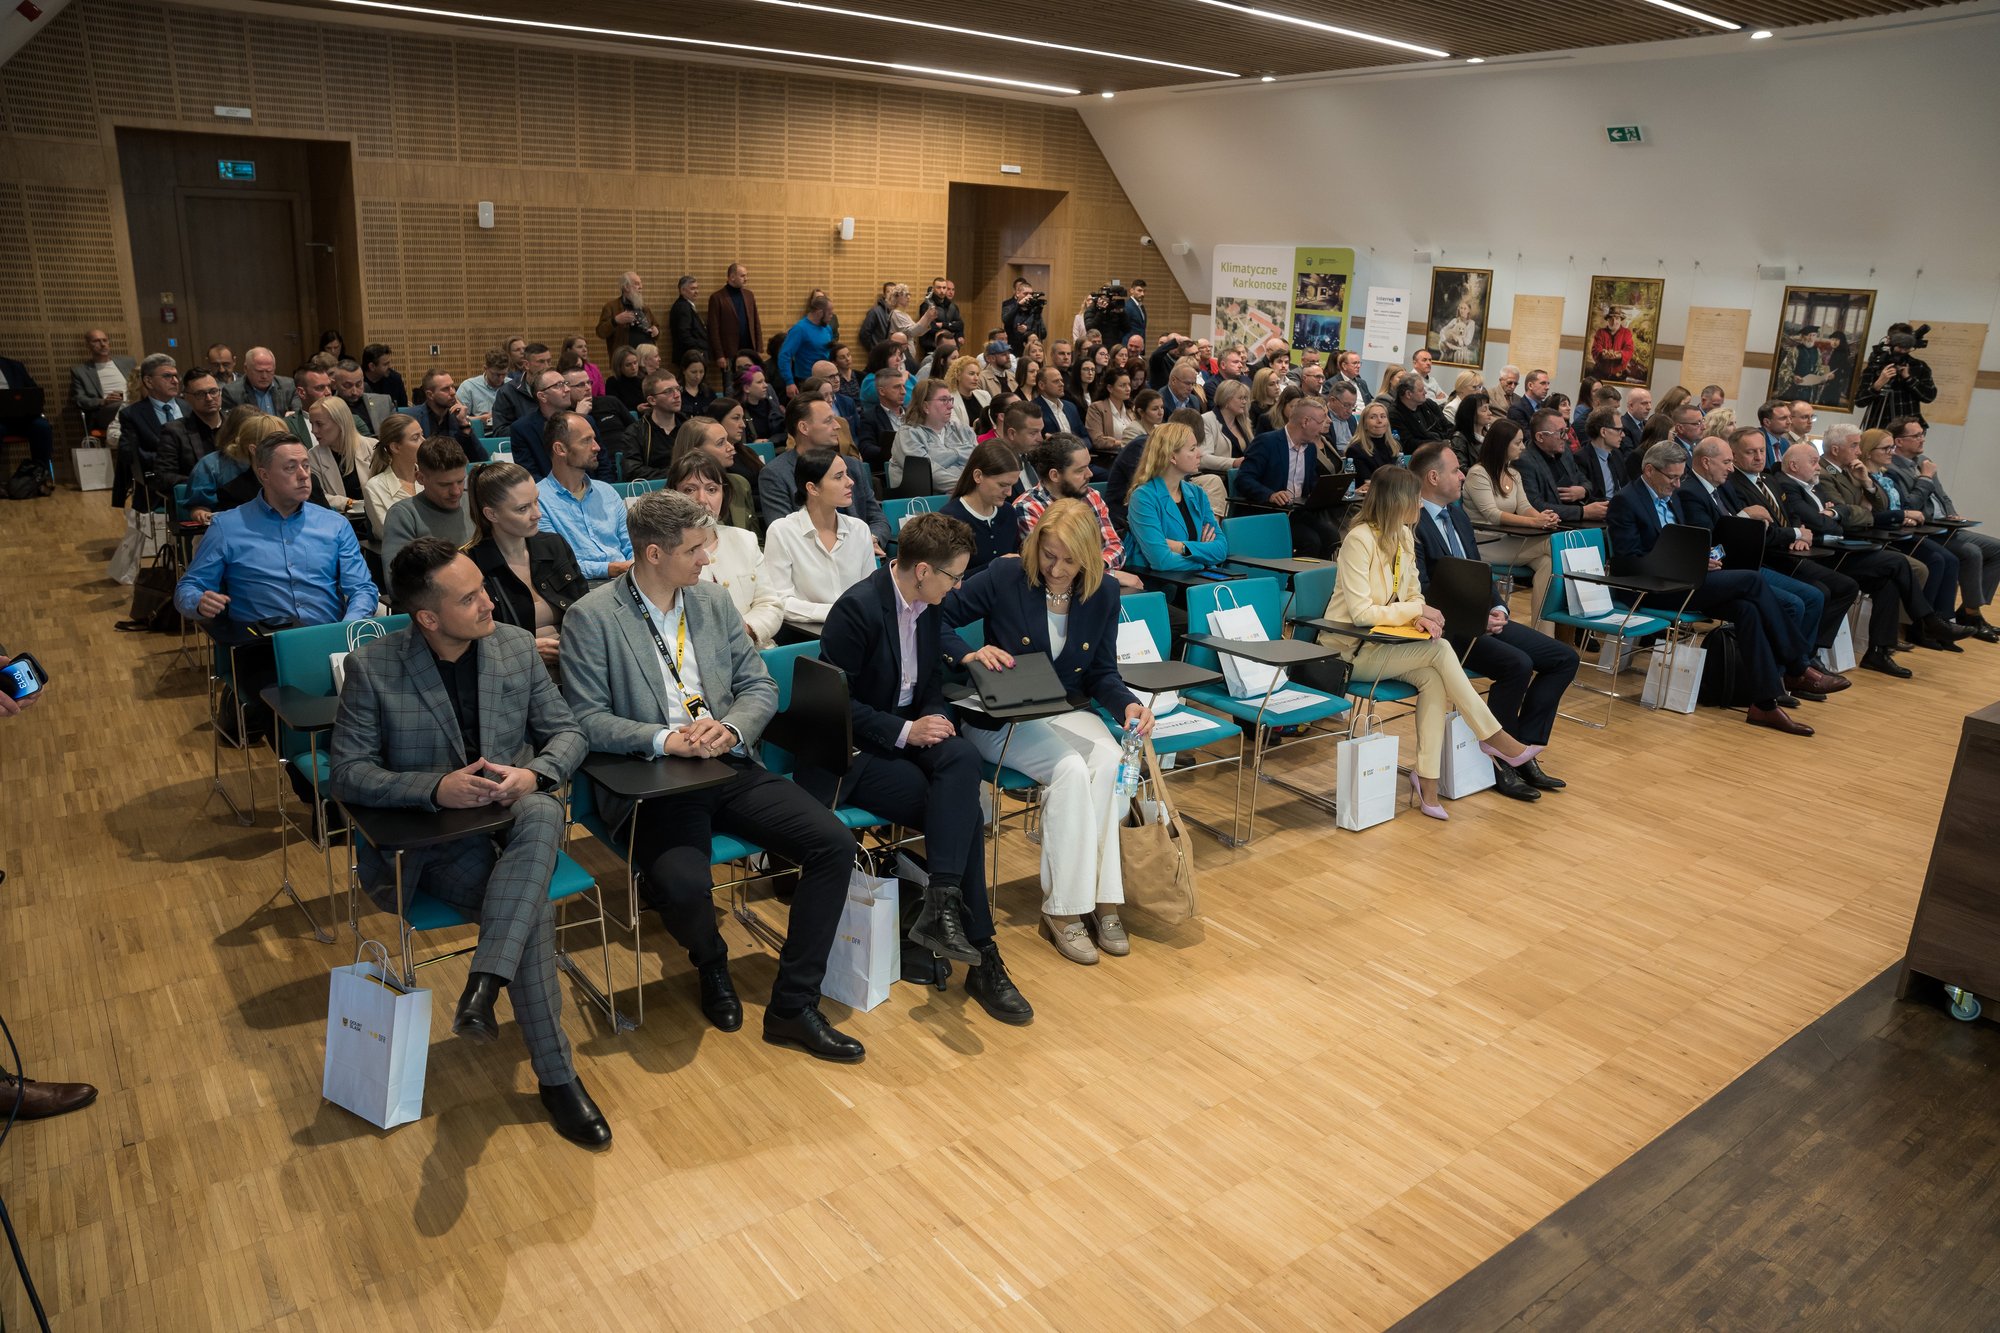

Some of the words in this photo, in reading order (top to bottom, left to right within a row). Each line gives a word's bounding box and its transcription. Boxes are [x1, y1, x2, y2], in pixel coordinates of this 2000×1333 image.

[1220, 262, 1278, 277] Klimatyczne
[1232, 277, 1288, 291] Karkonosze
[13, 670, 27, 689] 10:13
